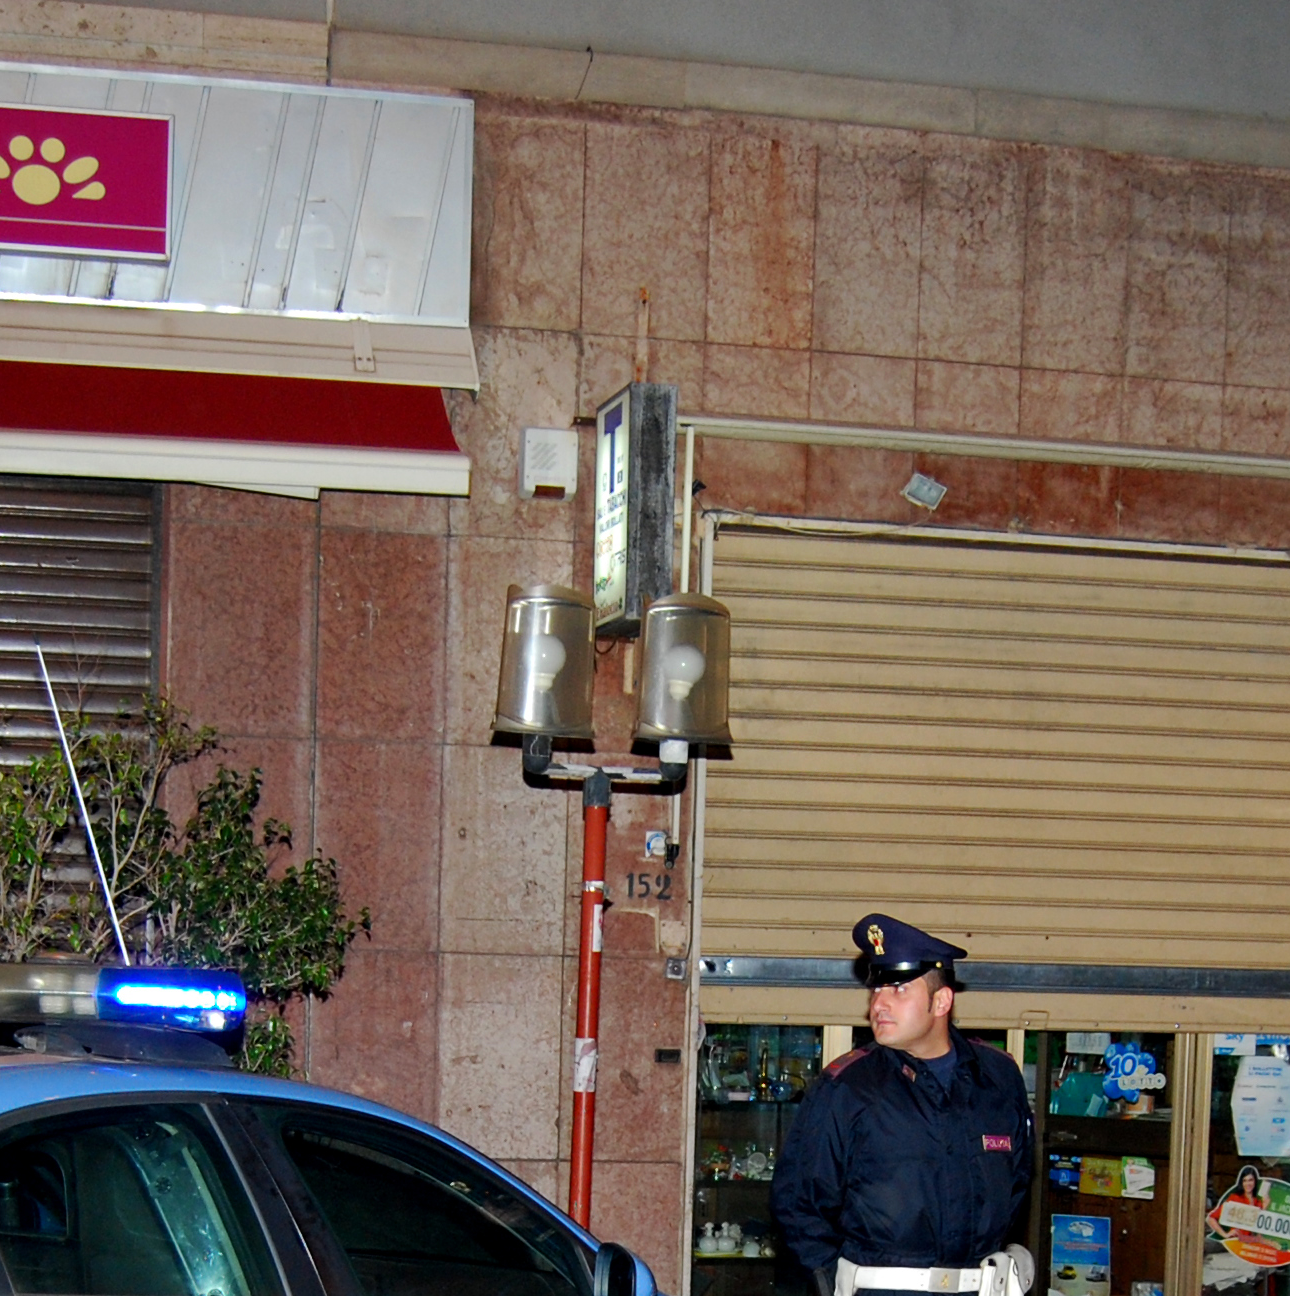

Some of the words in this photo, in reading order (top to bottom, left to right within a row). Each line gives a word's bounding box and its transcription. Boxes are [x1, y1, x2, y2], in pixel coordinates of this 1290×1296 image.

[626, 872, 672, 900] 152
[1110, 1053, 1139, 1080] 10
[1120, 1075, 1164, 1088] LOTTO
